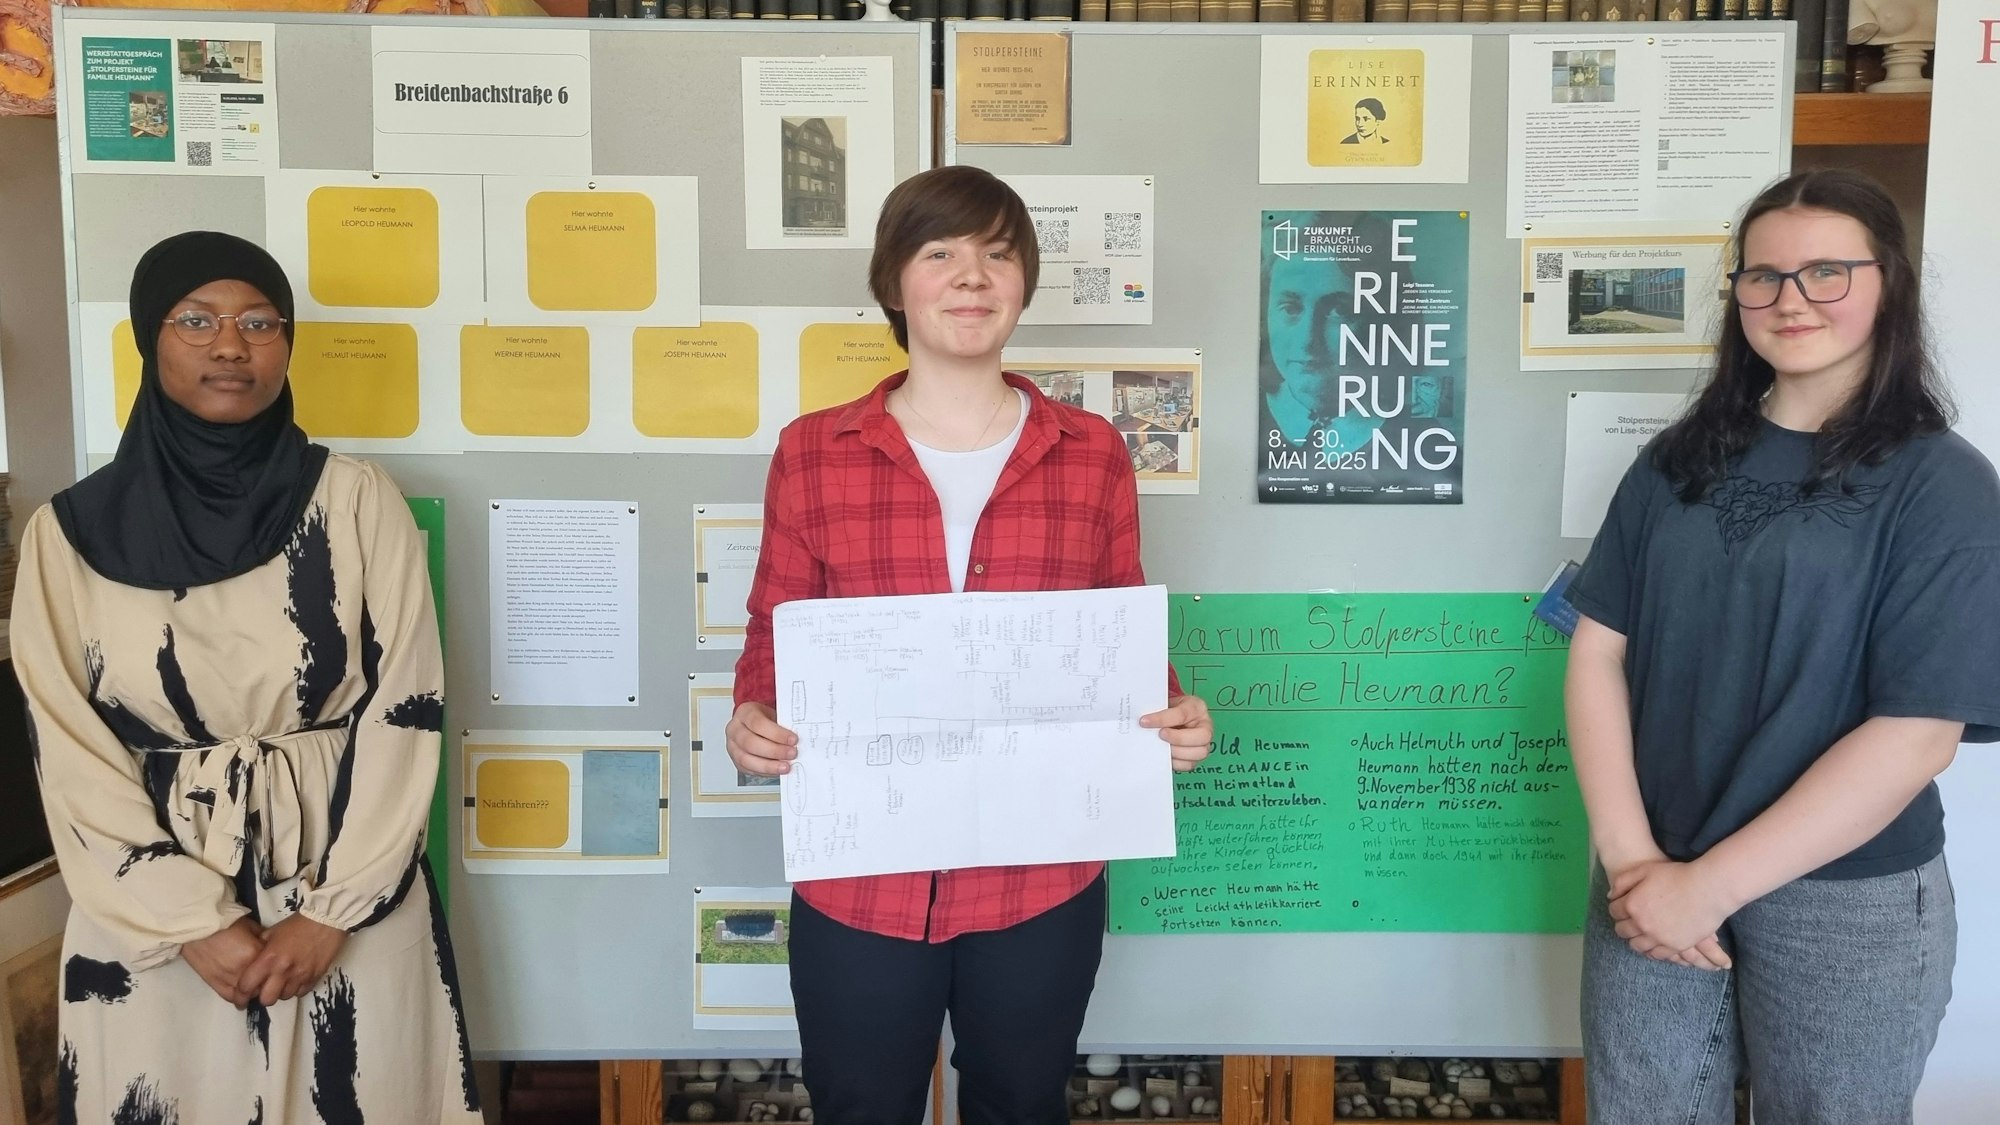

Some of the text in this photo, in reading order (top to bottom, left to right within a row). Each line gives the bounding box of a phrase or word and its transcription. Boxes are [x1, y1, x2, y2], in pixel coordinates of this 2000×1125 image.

[86, 50, 163, 58] WERKSTATTGESPRÄCH
[973, 47, 1043, 58] STOLPERSTEINE
[144, 65, 157, 73] FÜR
[1348, 61, 1385, 69] LISE
[1313, 75, 1420, 88] ERINNERT
[394, 83, 569, 106] Breidenbachstraße 6
[1026, 205, 1079, 214] rsteinprojekt
[1303, 227, 1353, 235] ZUKUNFT
[1310, 236, 1360, 244] BRAUCHT
[1303, 245, 1373, 254] ERINNERUNG
[1573, 250, 1606, 260] Werbung
[1609, 250, 1620, 258] für
[1638, 250, 1682, 259] Projektkurs
[1353, 271, 1398, 314] RI
[1339, 323, 1450, 366] NNE
[1338, 375, 1405, 418] RU
[1617, 416, 1670, 425] Stolpersteine
[1268, 430, 1287, 448] 8.
[1312, 430, 1345, 448] 30.
[1371, 427, 1458, 471] NG
[1268, 451, 1366, 470] MAI 2025
[1308, 605, 1504, 659] Stolpersteine
[1185, 661, 1515, 706] Familie Heumann?
[1209, 733, 1310, 756] old Heumann
[1359, 729, 1567, 760] Auch Helmuth und Joseph
[1228, 761, 1292, 774] CHANCE
[1295, 761, 1309, 771] in
[1358, 755, 1568, 774] Heumann hätten nach dem
[1173, 776, 1296, 791] nem Heimatland
[1441, 776, 1476, 794] 1938
[1480, 779, 1518, 793] nicht
[1523, 781, 1560, 792] aus-
[482, 799, 550, 810] Nachfahren???
[1174, 793, 1327, 810] utschland weiterzuleben.
[1357, 796, 1502, 811] wandern müssen.
[1205, 819, 1255, 831] Heumann
[1259, 814, 1296, 831] hätte
[1360, 816, 1412, 833] Ruth
[1421, 816, 1470, 831] Heumann
[1176, 830, 1322, 847] häft weiterführen können
[1362, 838, 1382, 848] mit
[1389, 836, 1416, 847] ihrer
[1426, 836, 1470, 847] Mutter
[1182, 849, 1207, 860] ihre
[1214, 846, 1261, 857] Kinder
[1266, 841, 1324, 860] glücklich
[1364, 850, 1382, 862] und
[1389, 850, 1417, 861] dann
[1422, 850, 1448, 861] doch
[1453, 851, 1483, 861] 1941
[1488, 851, 1503, 860] mit
[1511, 850, 1526, 861] ihr
[1225, 859, 1262, 871] sehen
[1269, 858, 1318, 870] können.
[1154, 880, 1320, 900] Werner Heumann hätte
[1154, 905, 1184, 917] seine
[1161, 917, 1282, 933] fortsetzen können.
